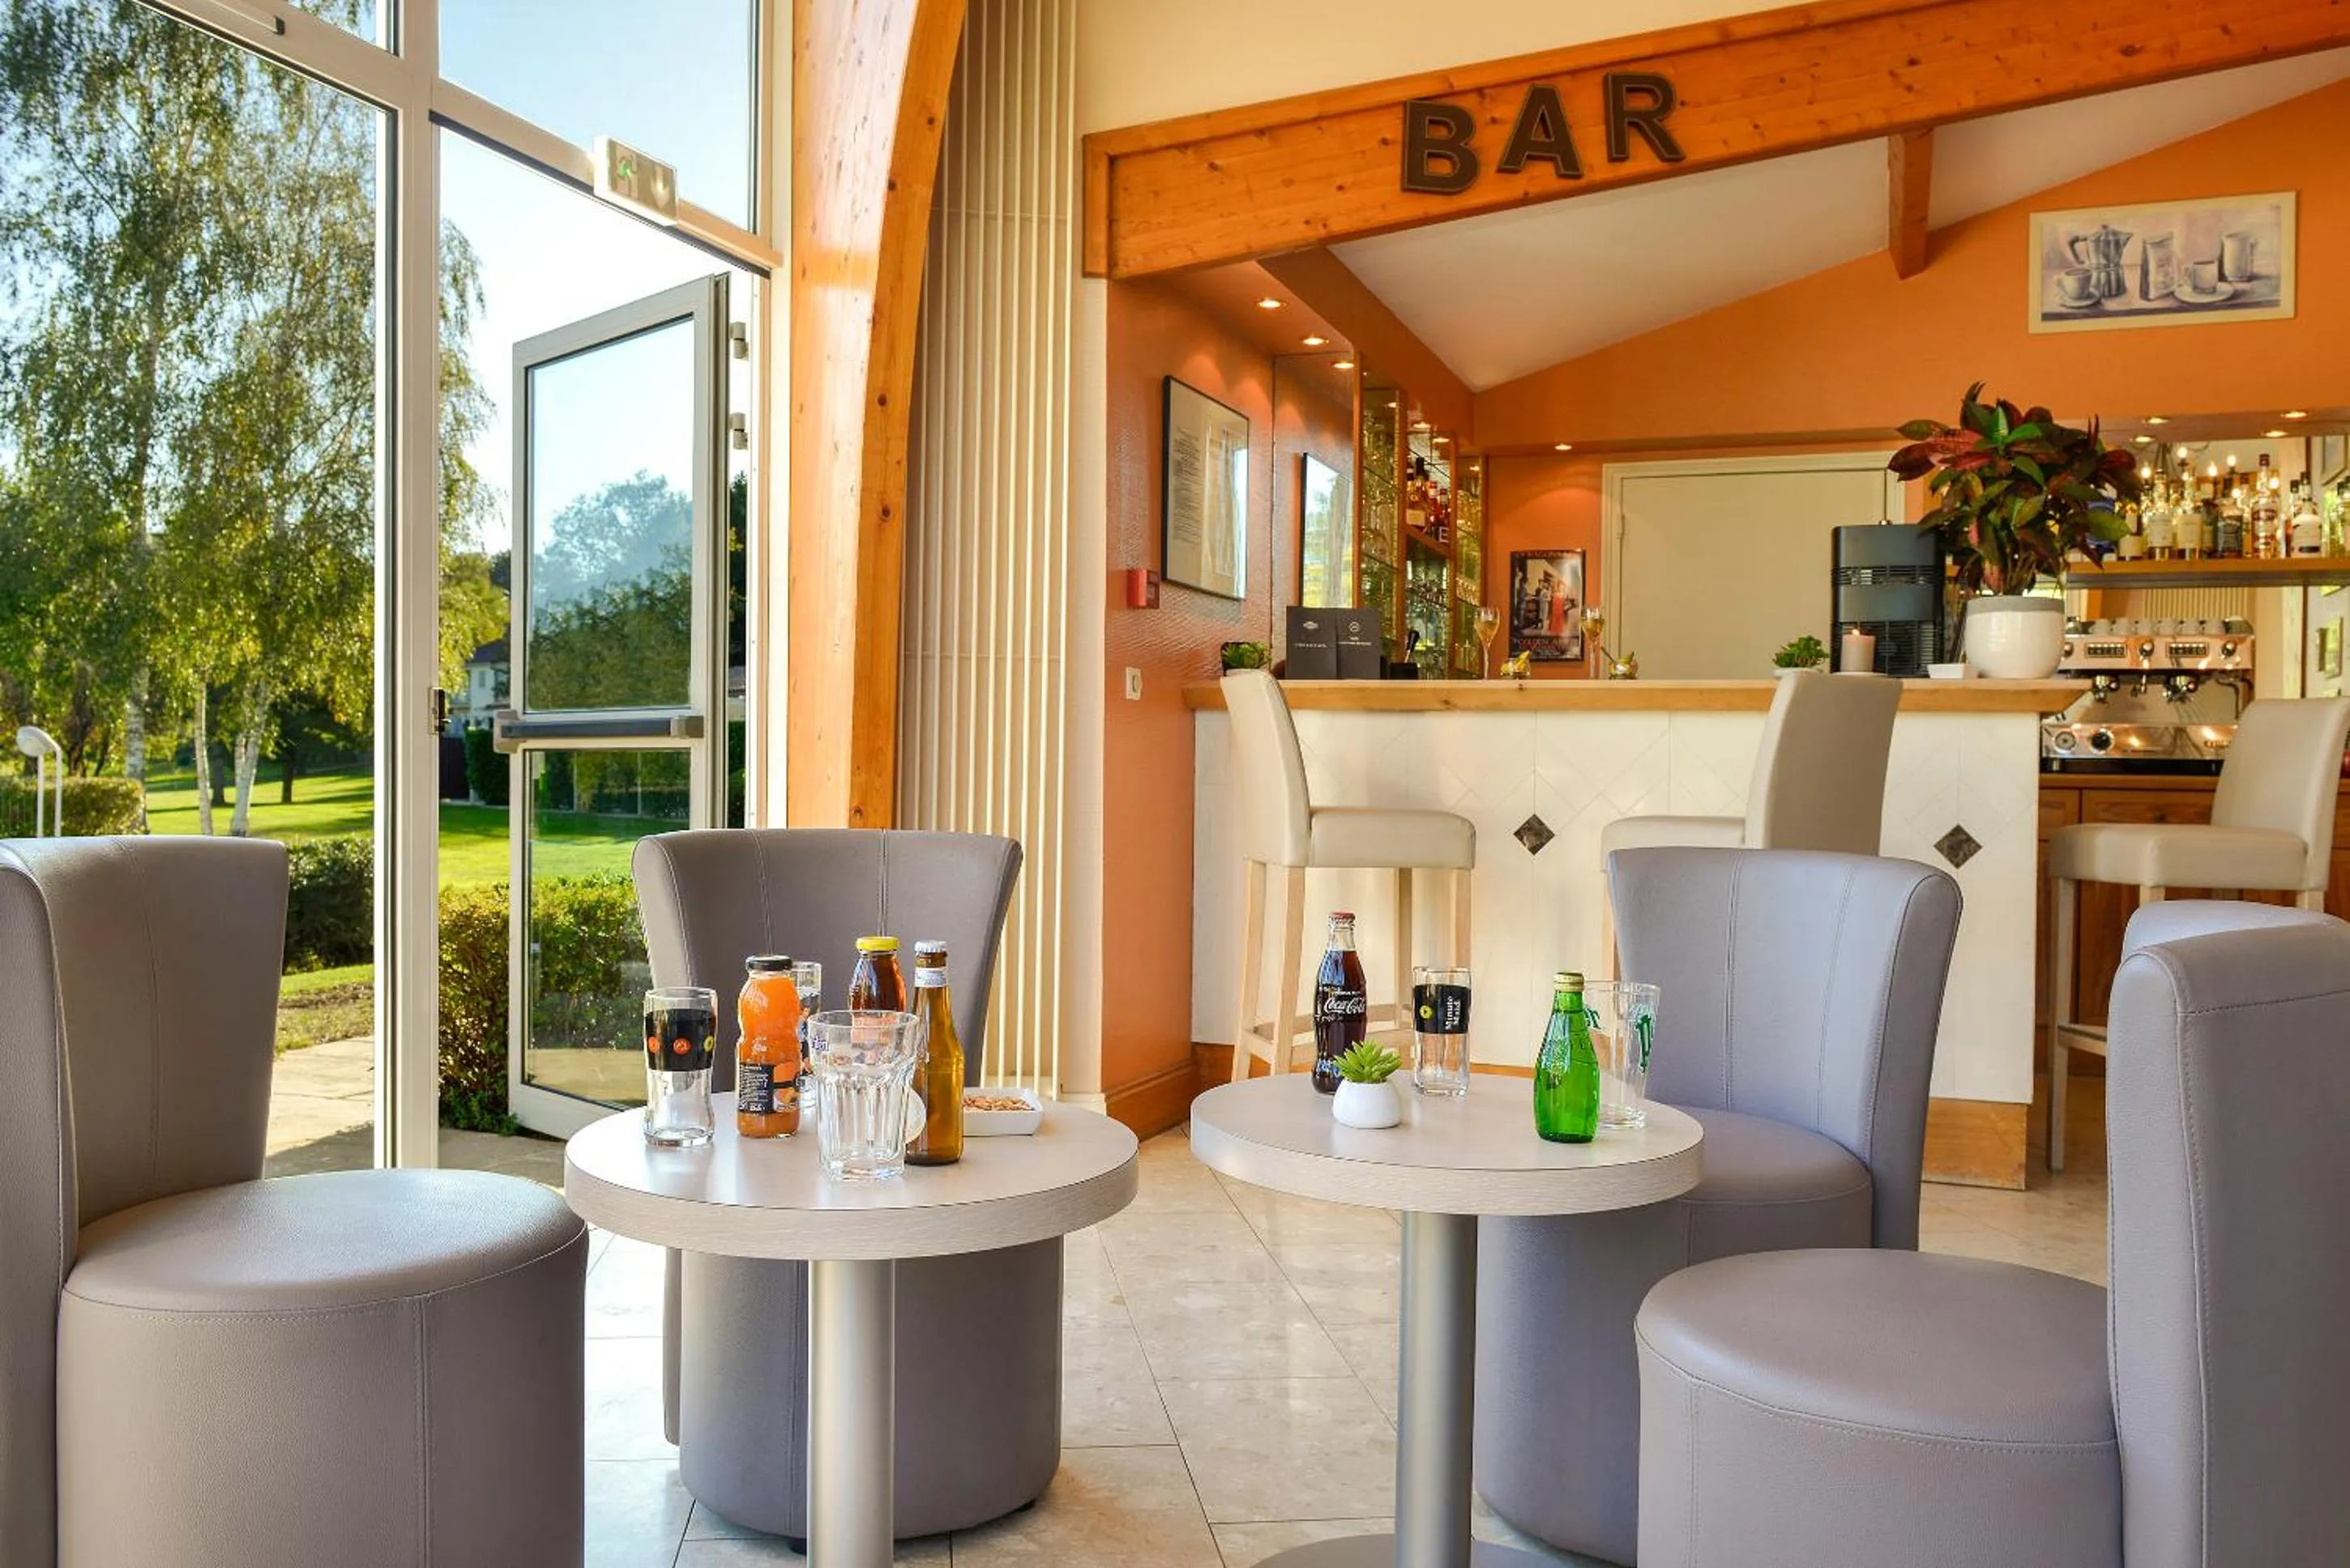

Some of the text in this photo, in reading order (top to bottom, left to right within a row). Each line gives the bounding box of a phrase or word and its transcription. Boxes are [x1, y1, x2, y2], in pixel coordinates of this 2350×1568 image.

[1400, 70, 1686, 195] BAR
[1445, 996, 1454, 1030] Minute
[1453, 999, 1461, 1025] Maid
